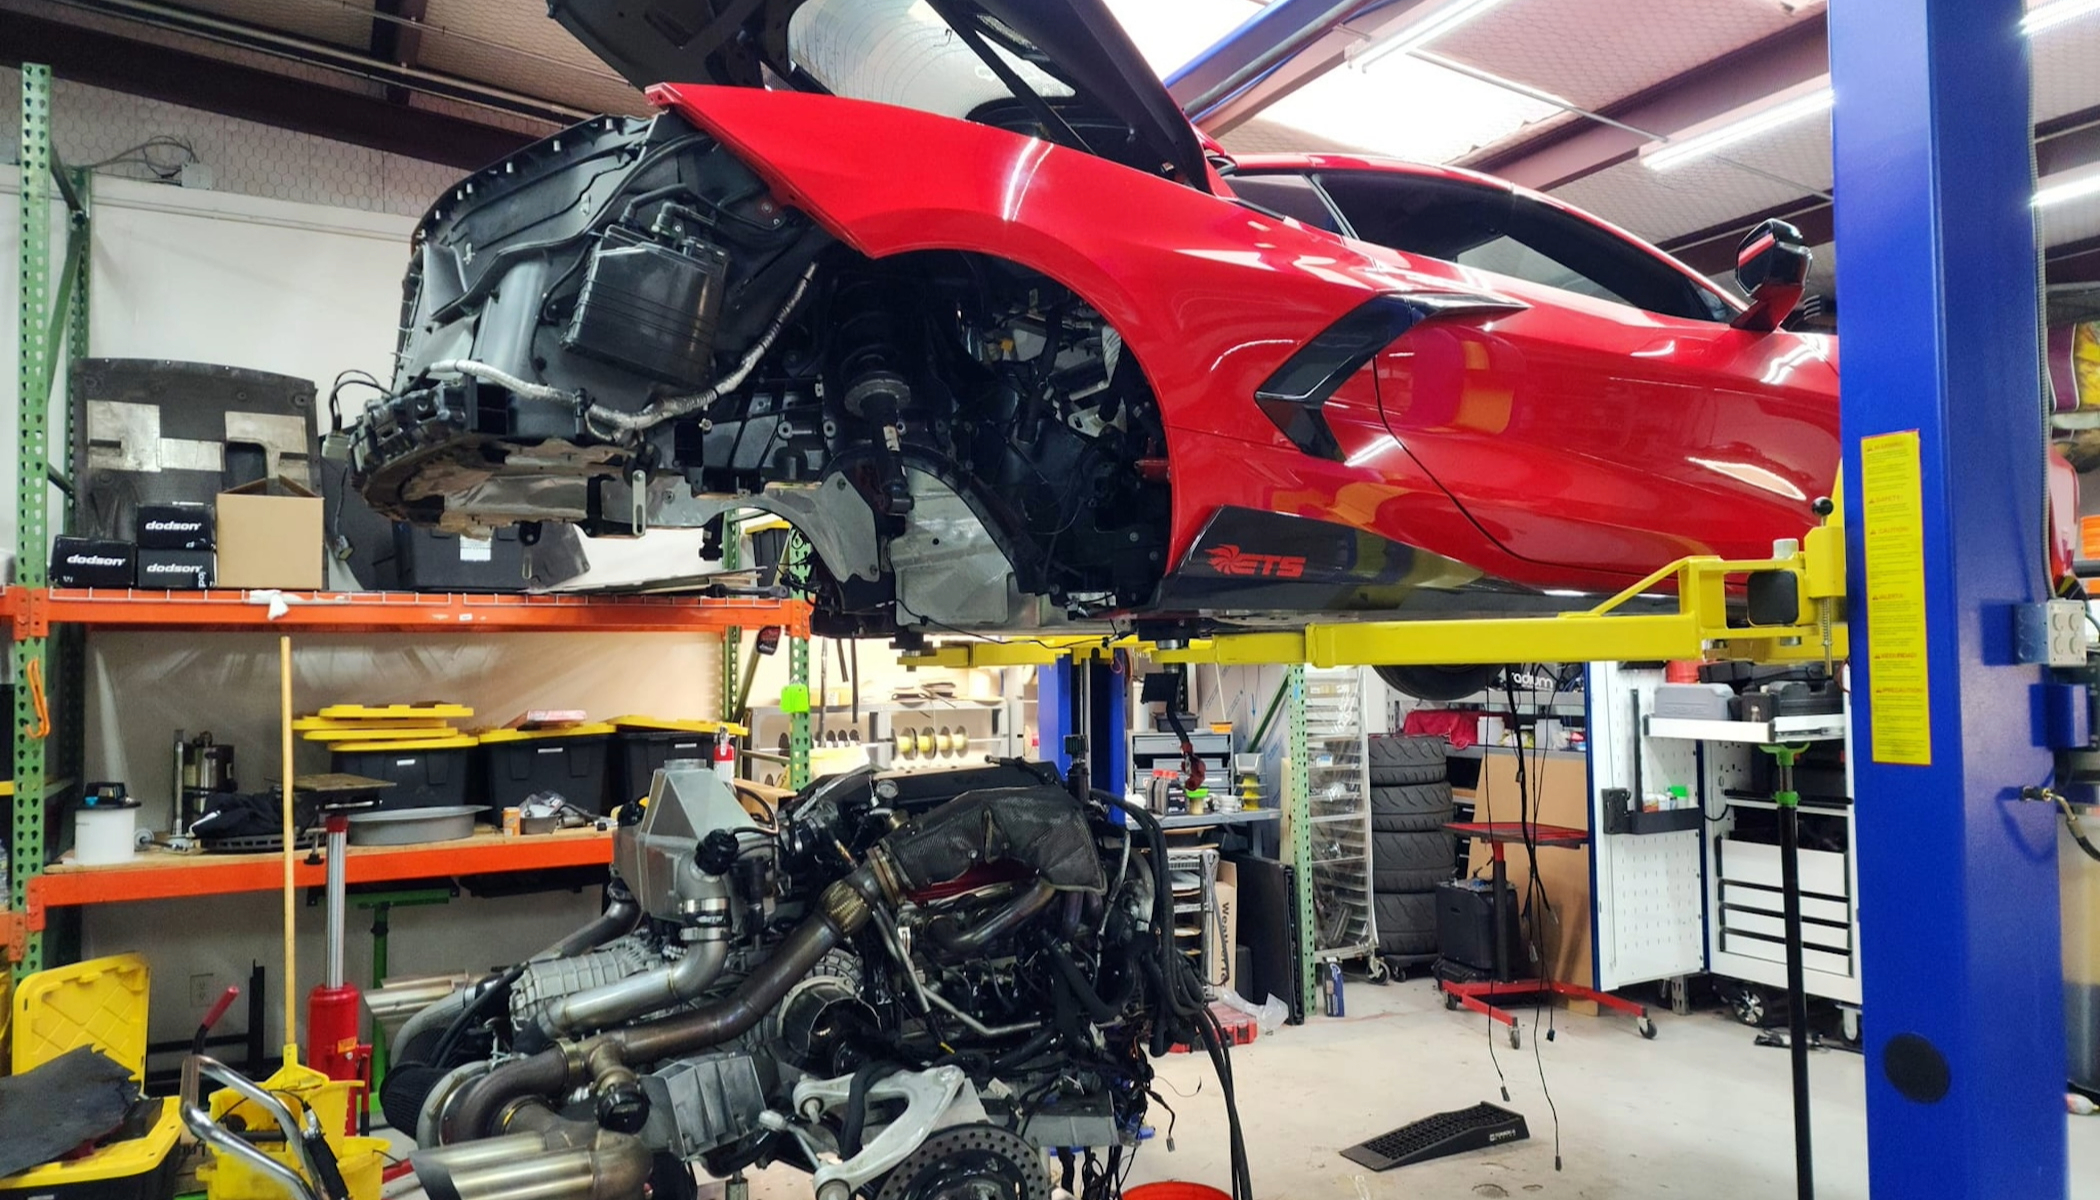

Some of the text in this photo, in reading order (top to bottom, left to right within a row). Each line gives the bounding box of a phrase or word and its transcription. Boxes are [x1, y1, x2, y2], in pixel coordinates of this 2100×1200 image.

[145, 520, 201, 531] dodson
[67, 554, 126, 567] dodson
[1231, 552, 1307, 577] ETS
[146, 563, 203, 574] dodson
